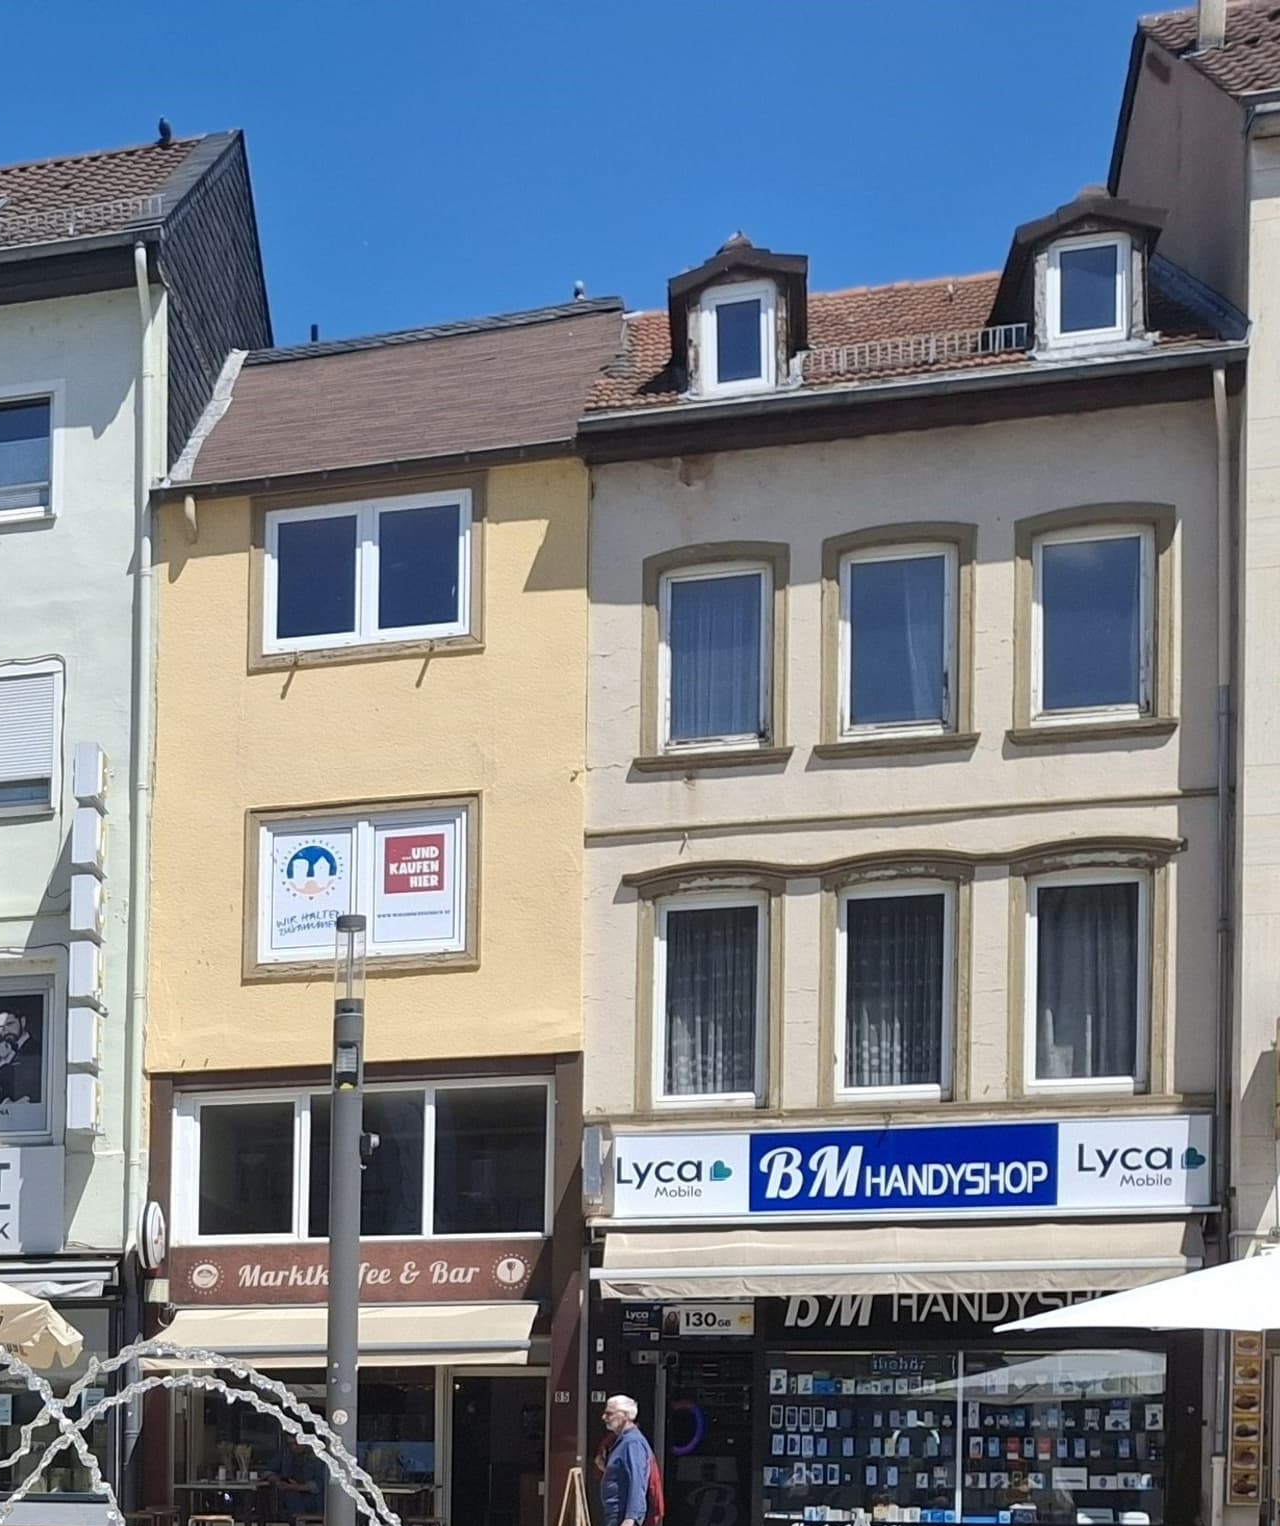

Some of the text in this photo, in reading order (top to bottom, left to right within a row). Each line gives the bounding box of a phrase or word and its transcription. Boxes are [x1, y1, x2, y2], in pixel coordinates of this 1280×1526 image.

[389, 861, 439, 875] KAUFEN
[410, 876, 439, 888] HIER
[276, 915, 299, 928] WIR
[1077, 1142, 1174, 1177] Lyca
[616, 1156, 703, 1190] Lyca
[758, 1145, 1049, 1200] BM HANDYSHOP
[1120, 1172, 1173, 1188] Mobile
[654, 1184, 702, 1198] Mobile
[238, 1261, 480, 1289] Marktkfee & Bar
[625, 1310, 649, 1320] Lyca
[685, 1312, 717, 1327] 130
